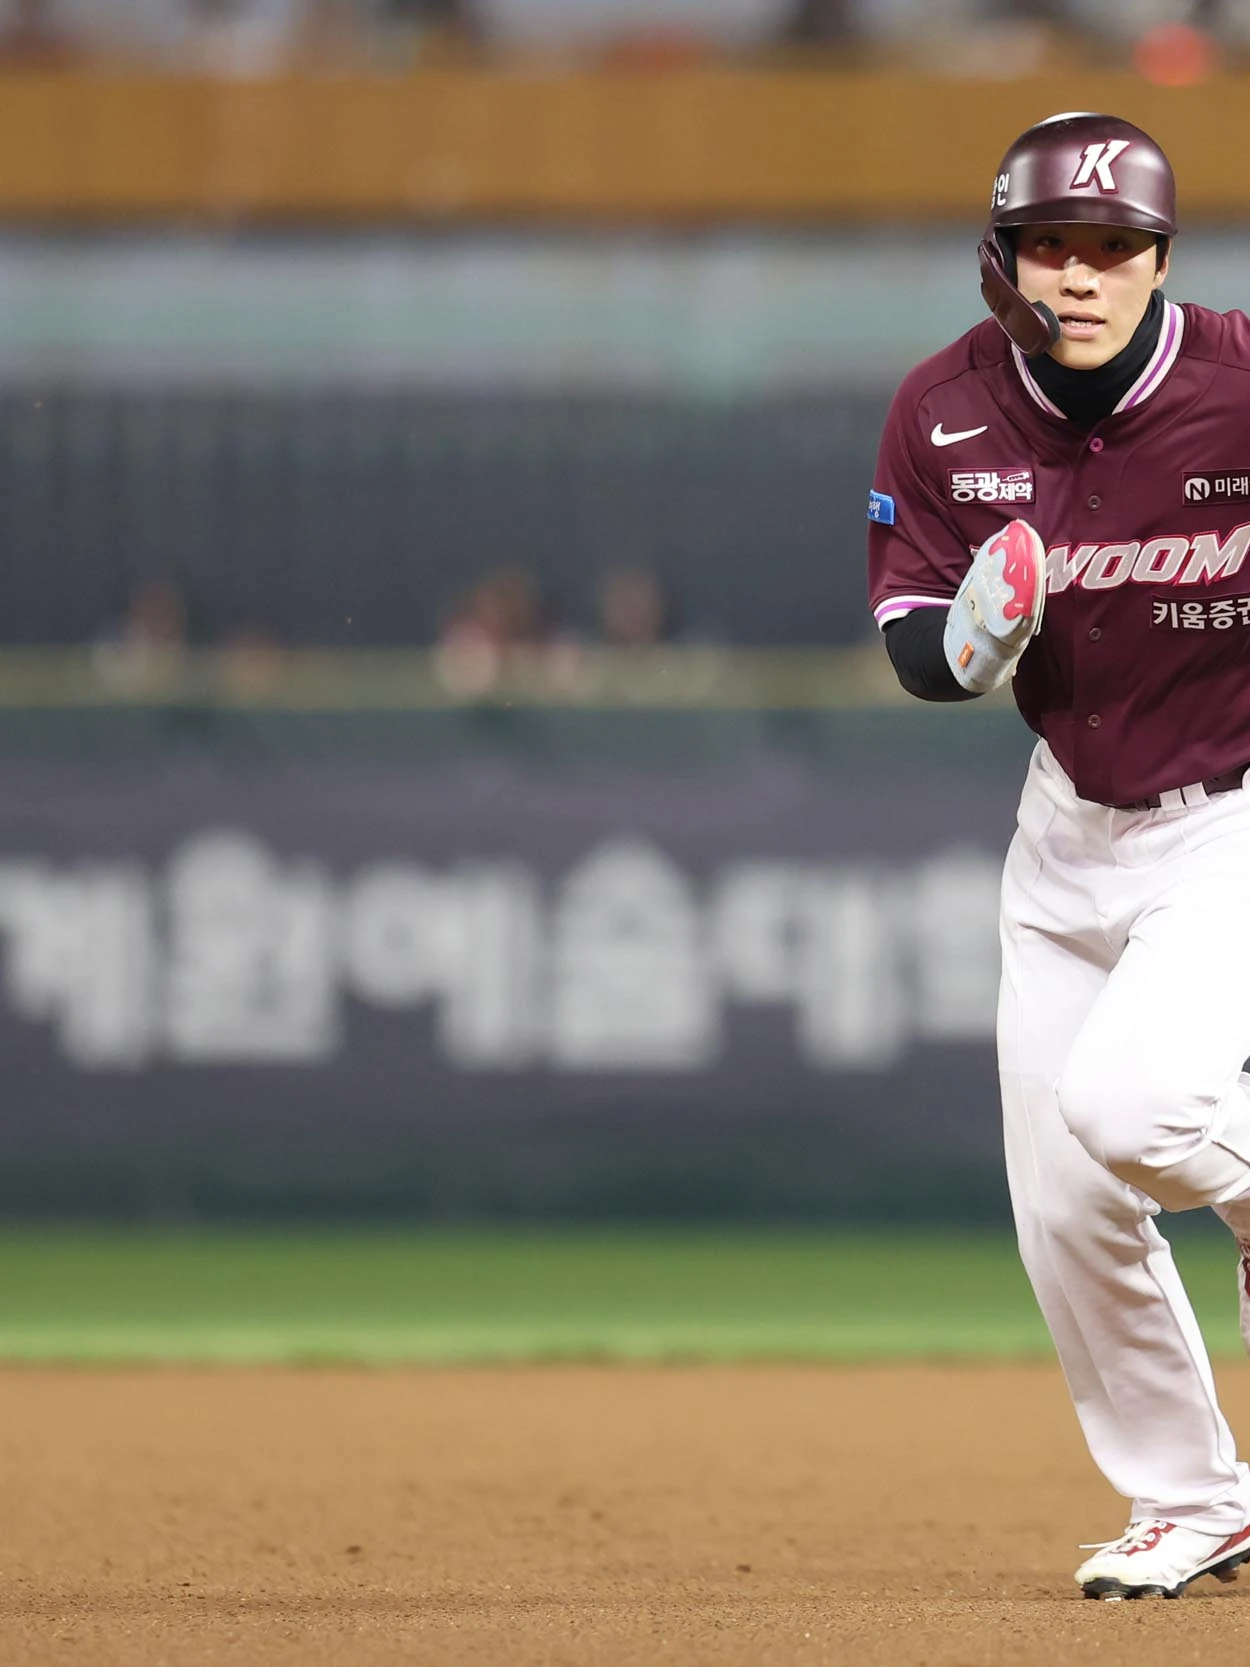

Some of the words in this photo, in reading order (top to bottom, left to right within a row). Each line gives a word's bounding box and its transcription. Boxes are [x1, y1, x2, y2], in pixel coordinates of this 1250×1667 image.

[1071, 139, 1132, 194] K
[991, 173, 1010, 209] 인
[951, 472, 1033, 502] 동광제약
